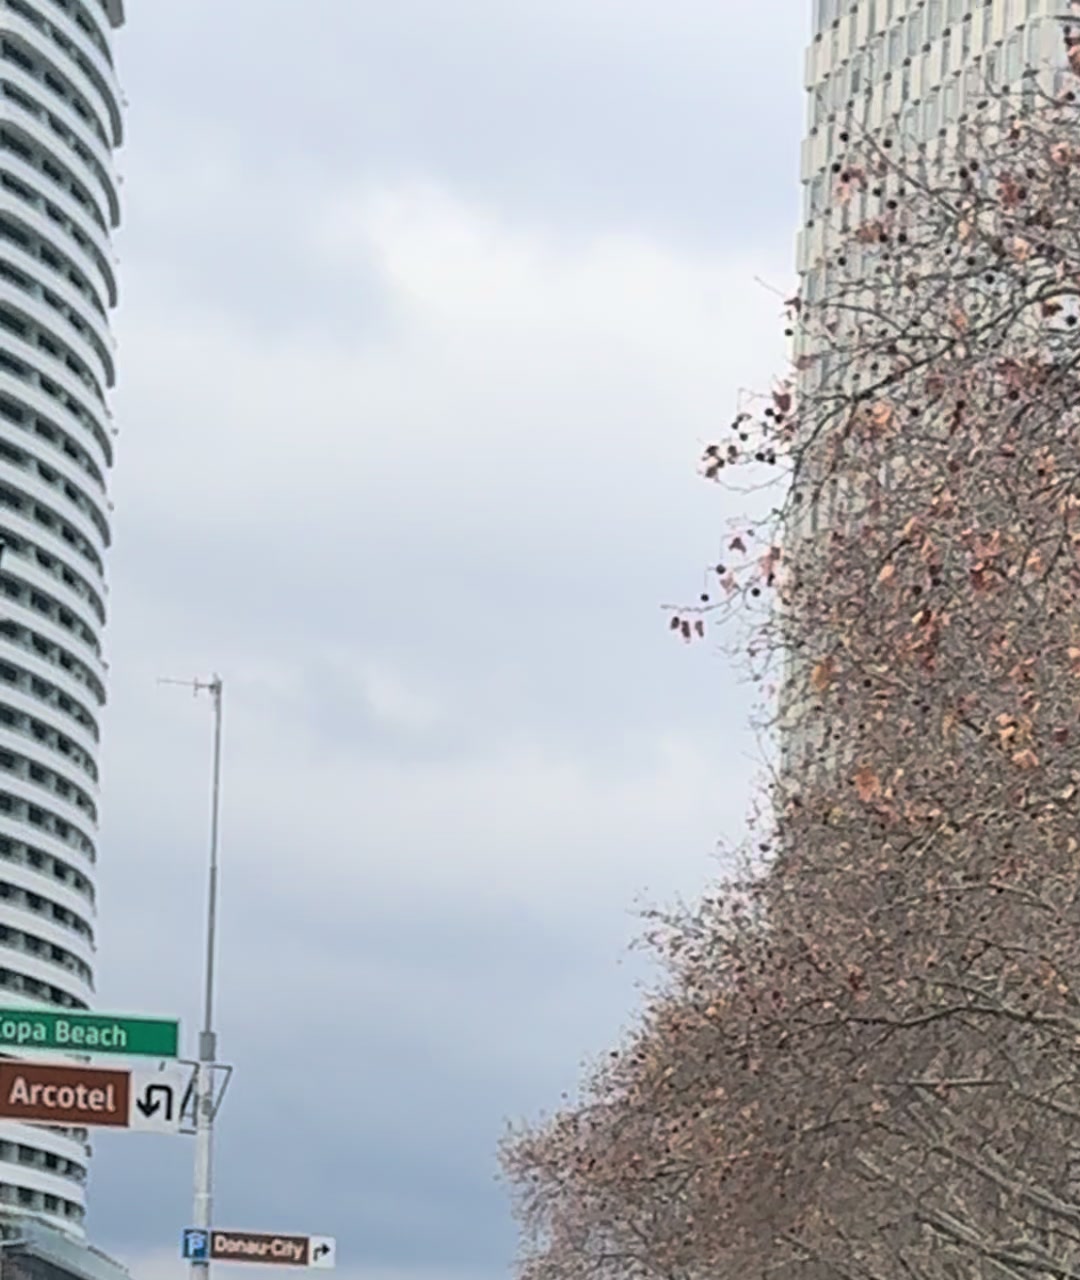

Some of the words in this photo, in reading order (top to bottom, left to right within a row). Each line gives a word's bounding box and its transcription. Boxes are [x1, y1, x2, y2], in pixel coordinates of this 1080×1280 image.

[55, 1020, 127, 1047] Beach
[9, 1077, 116, 1111] Arcotel
[214, 1234, 304, 1260] Donau-City
